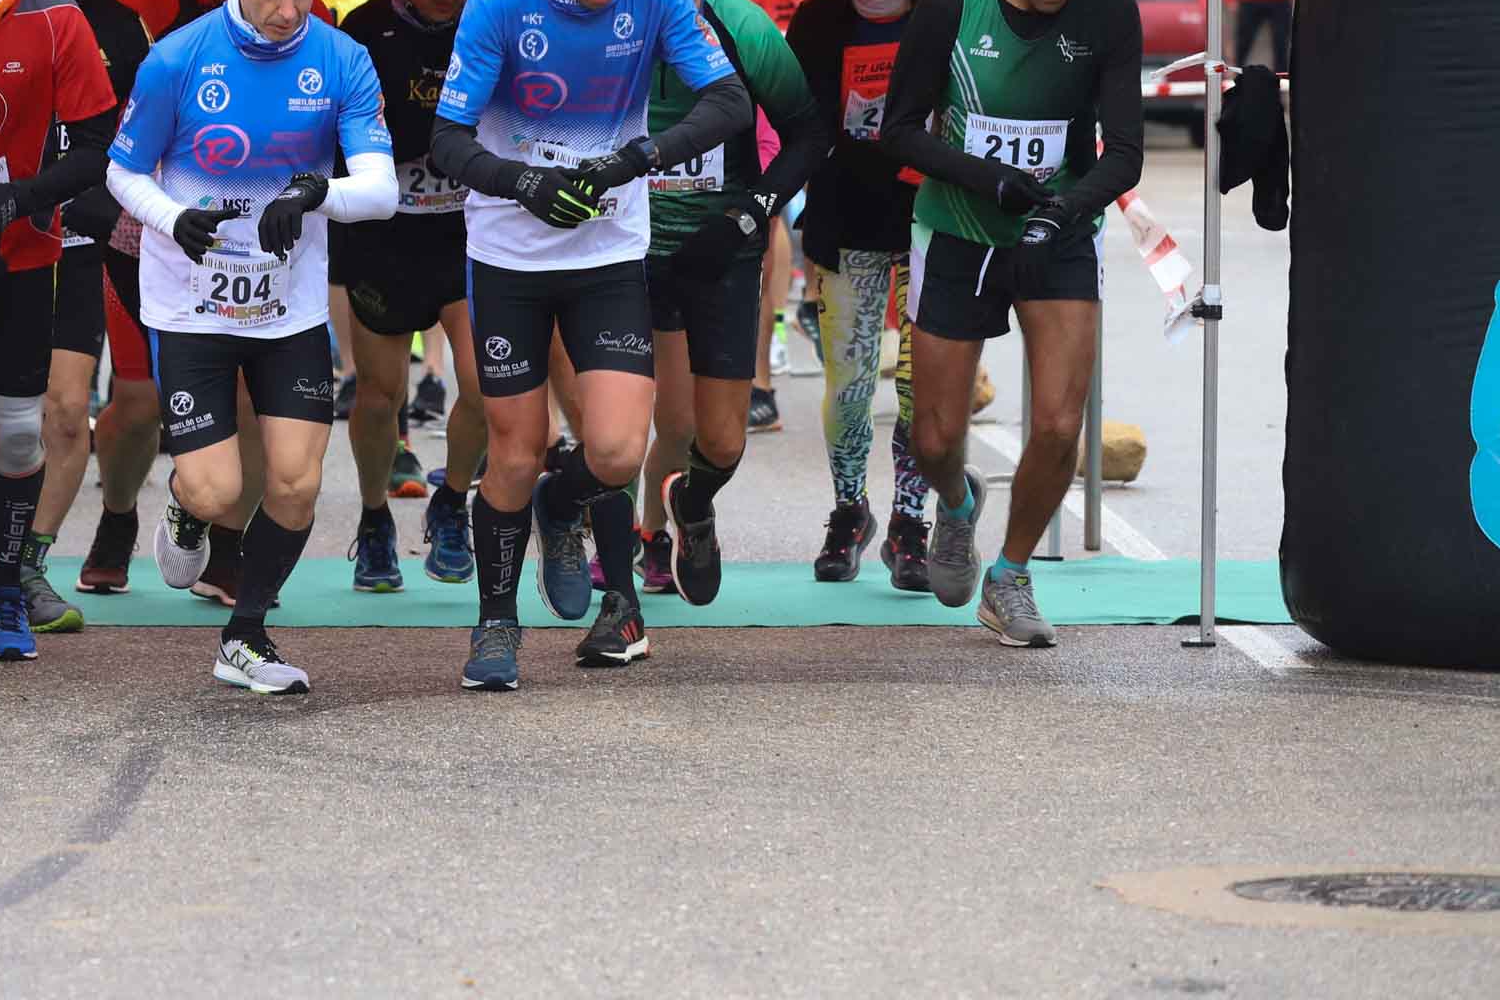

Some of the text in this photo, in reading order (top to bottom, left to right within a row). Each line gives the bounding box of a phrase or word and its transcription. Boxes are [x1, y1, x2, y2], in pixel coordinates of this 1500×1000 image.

[969, 47, 1000, 59] VIATOR
[984, 134, 1045, 168] 219
[210, 273, 272, 305] 204
